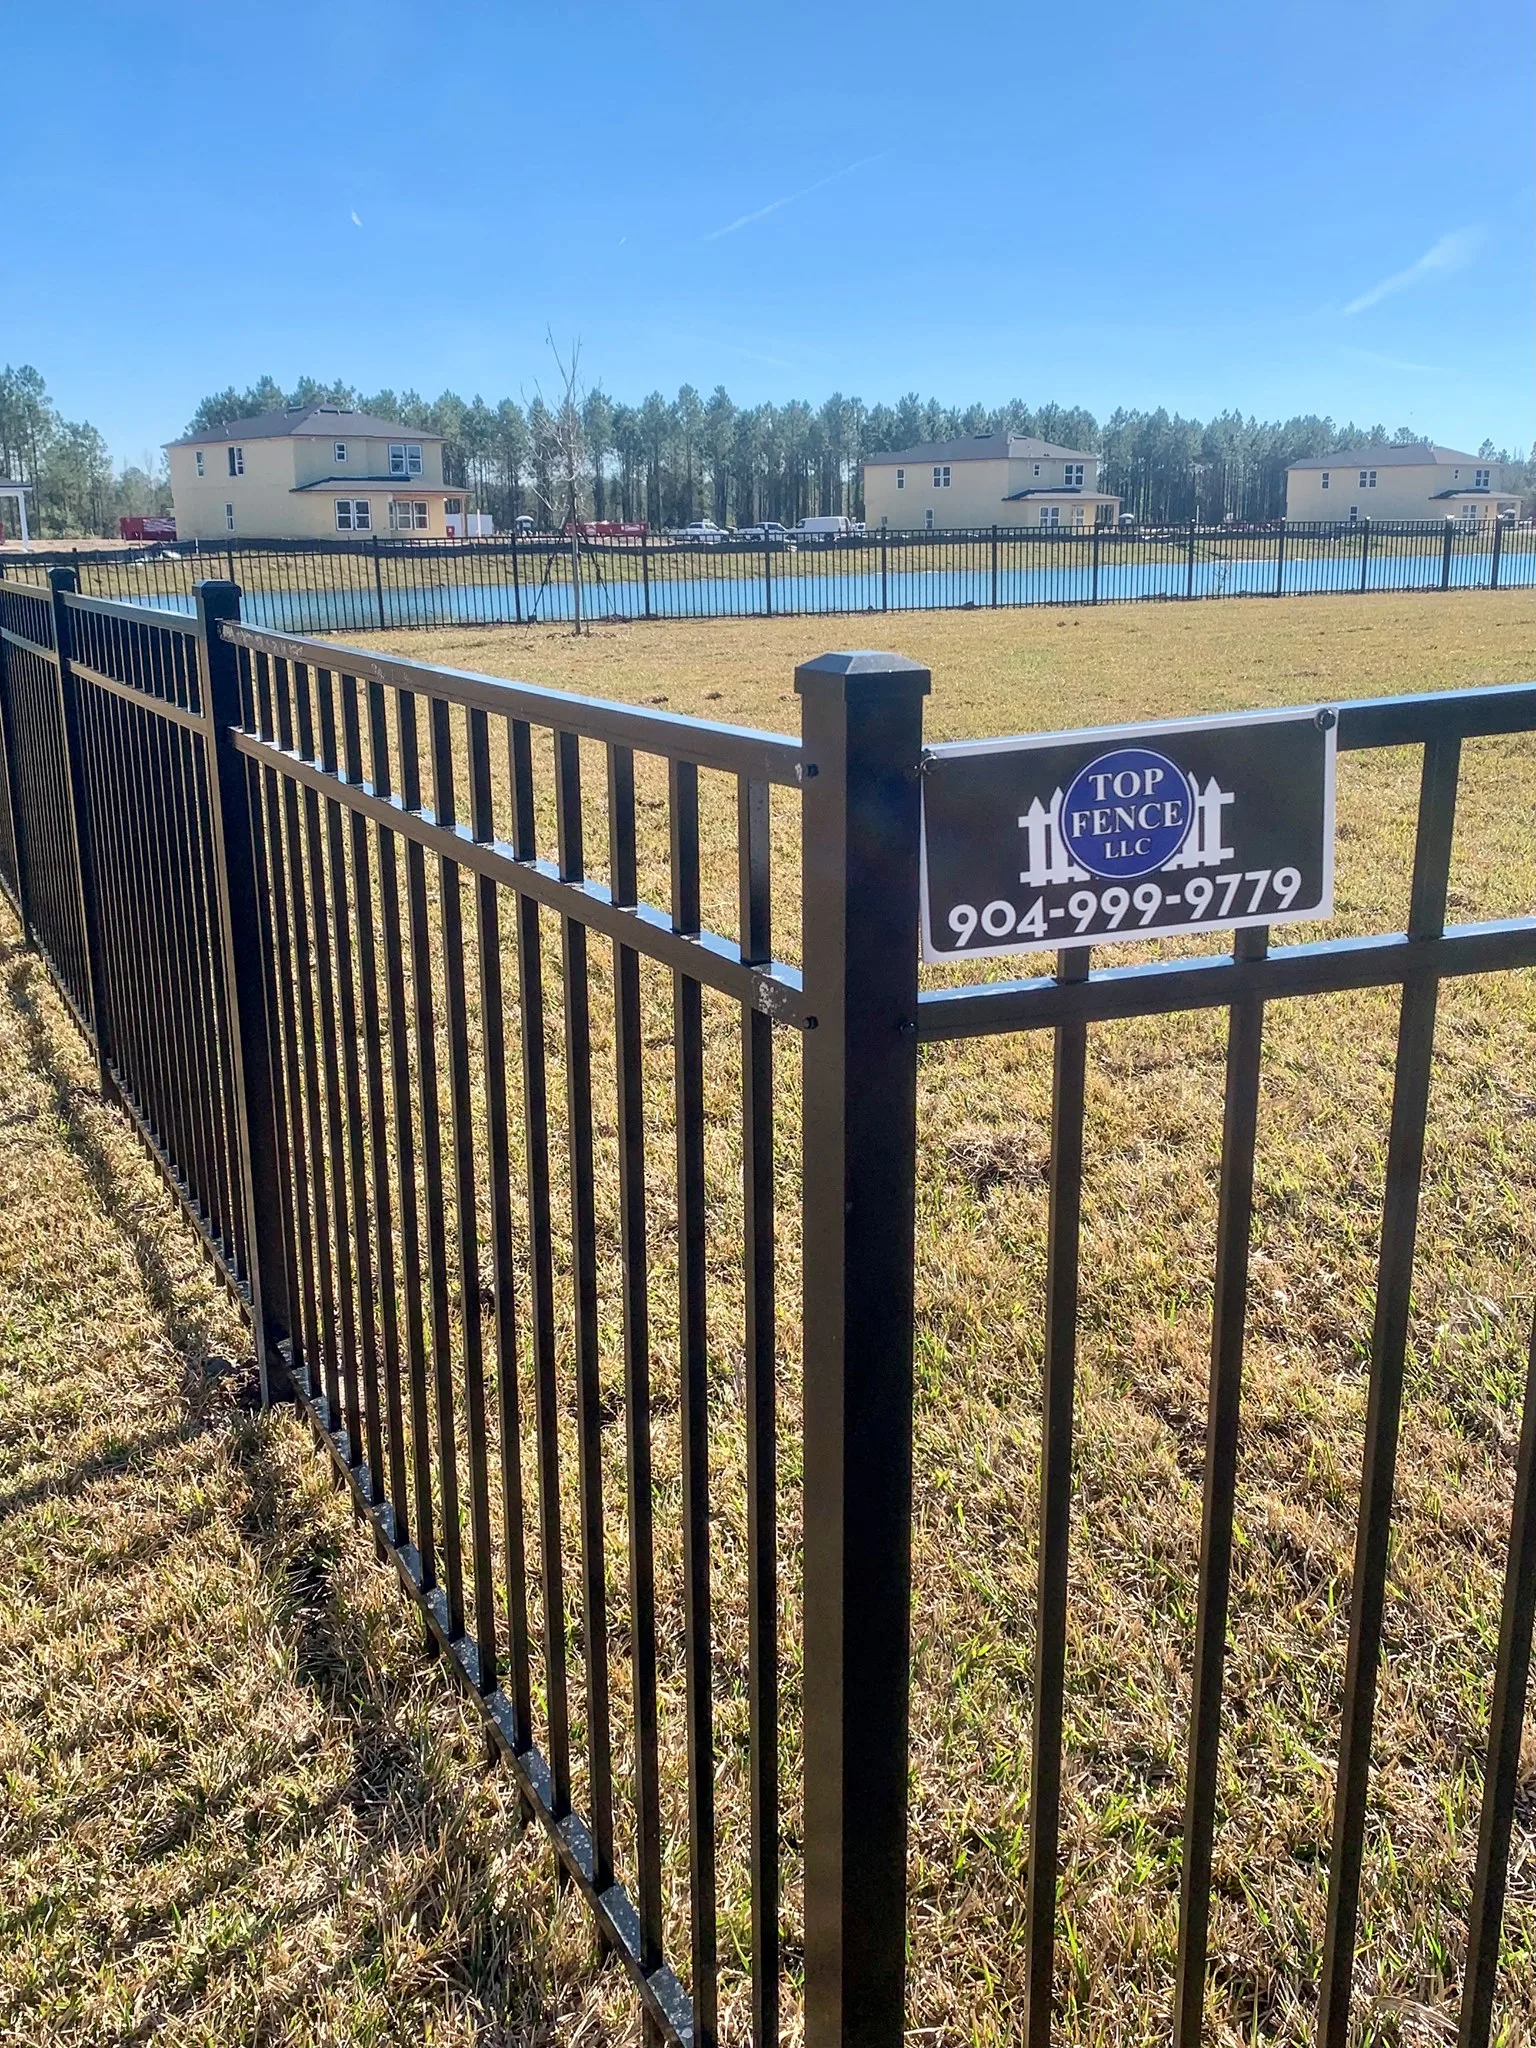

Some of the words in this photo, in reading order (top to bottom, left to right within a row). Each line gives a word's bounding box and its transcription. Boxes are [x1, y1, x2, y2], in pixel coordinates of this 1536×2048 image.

[1089, 768, 1165, 801] TOP
[1070, 799, 1184, 839] FENCE
[1105, 838, 1151, 859] LLC
[948, 867, 1302, 947] 904-999-9779
